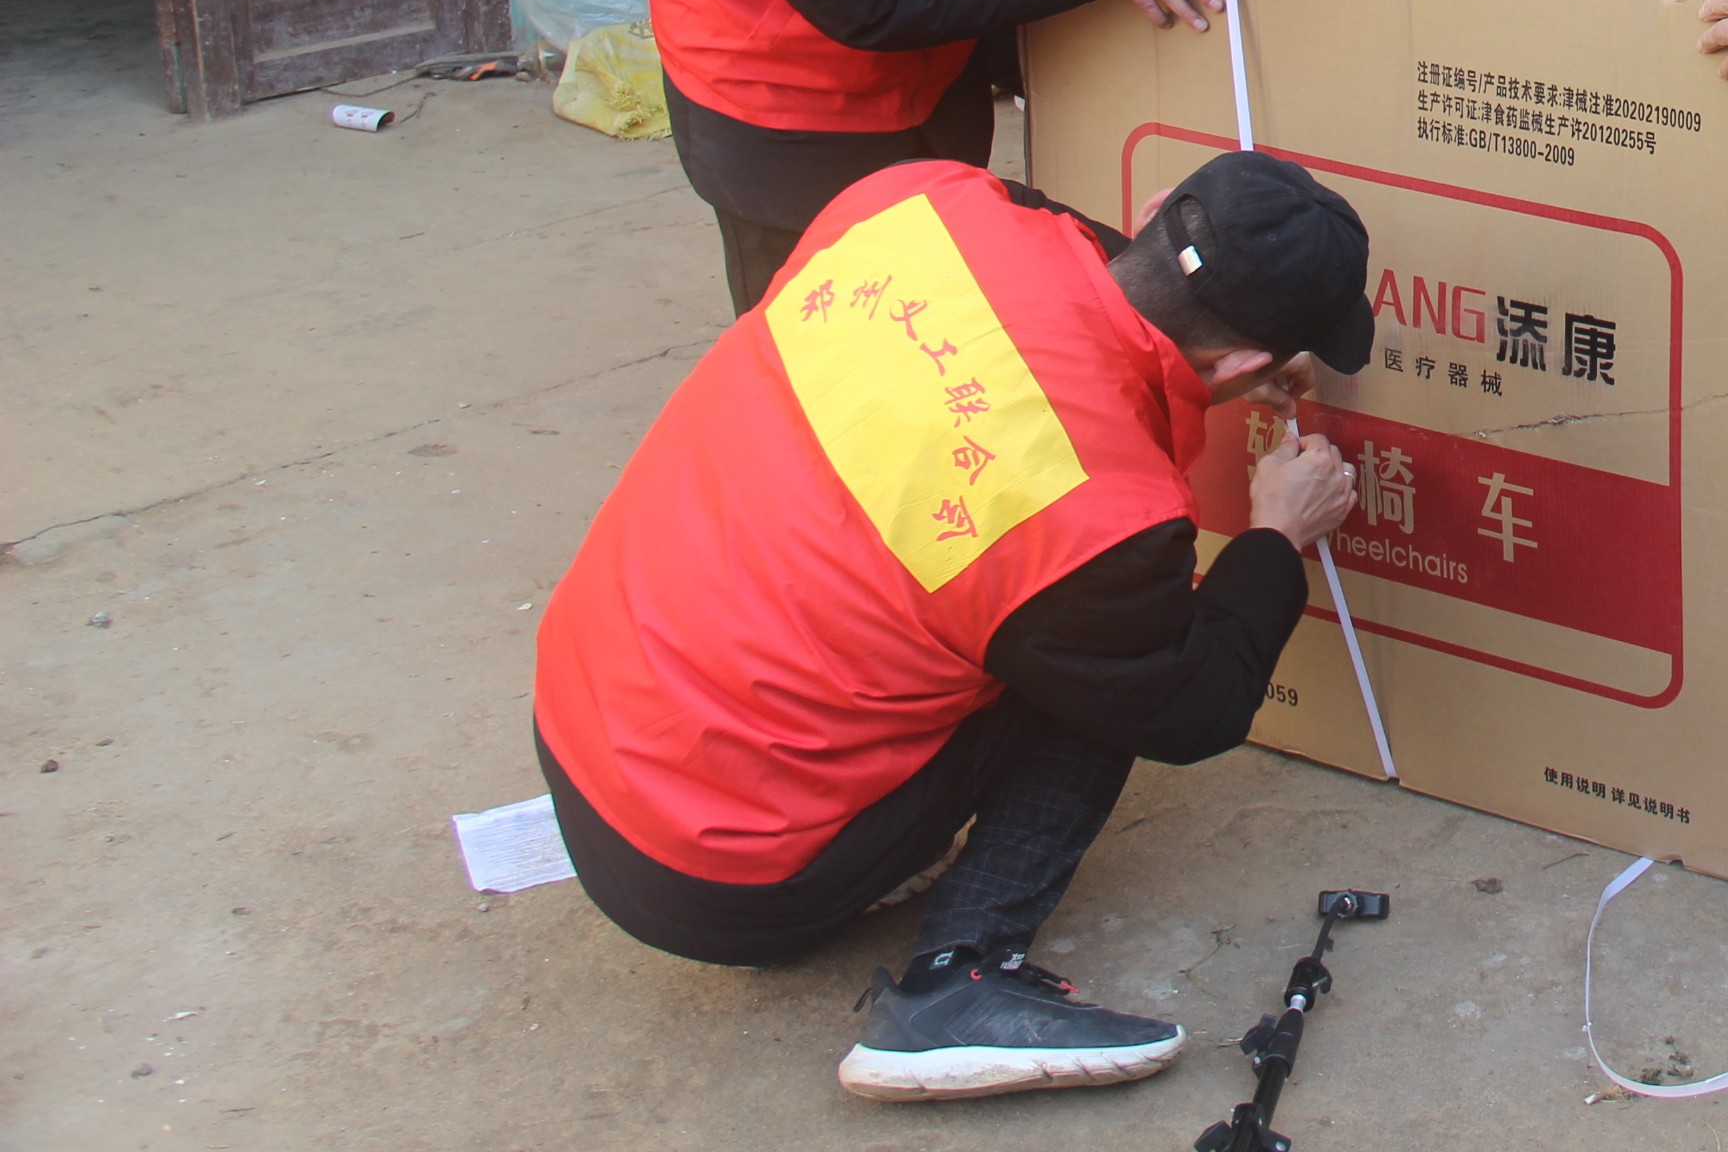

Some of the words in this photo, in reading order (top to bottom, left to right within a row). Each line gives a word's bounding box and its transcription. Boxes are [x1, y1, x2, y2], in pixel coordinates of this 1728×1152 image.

[1417, 60, 1702, 132] 注册证编号/产品技术要求:津械注准20202190009
[1417, 89, 1657, 155] 生产许可证:津食药监械生产许20120255号
[1417, 116, 1575, 166] 执行标准:GB/T13800-2009
[1384, 347, 1503, 396] 医疗器械
[1496, 295, 1617, 385] 添康
[800, 274, 997, 542] 邓州义工联合会
[1543, 765, 1606, 799] 使用说明
[1610, 785, 1692, 825] 详见说明书
